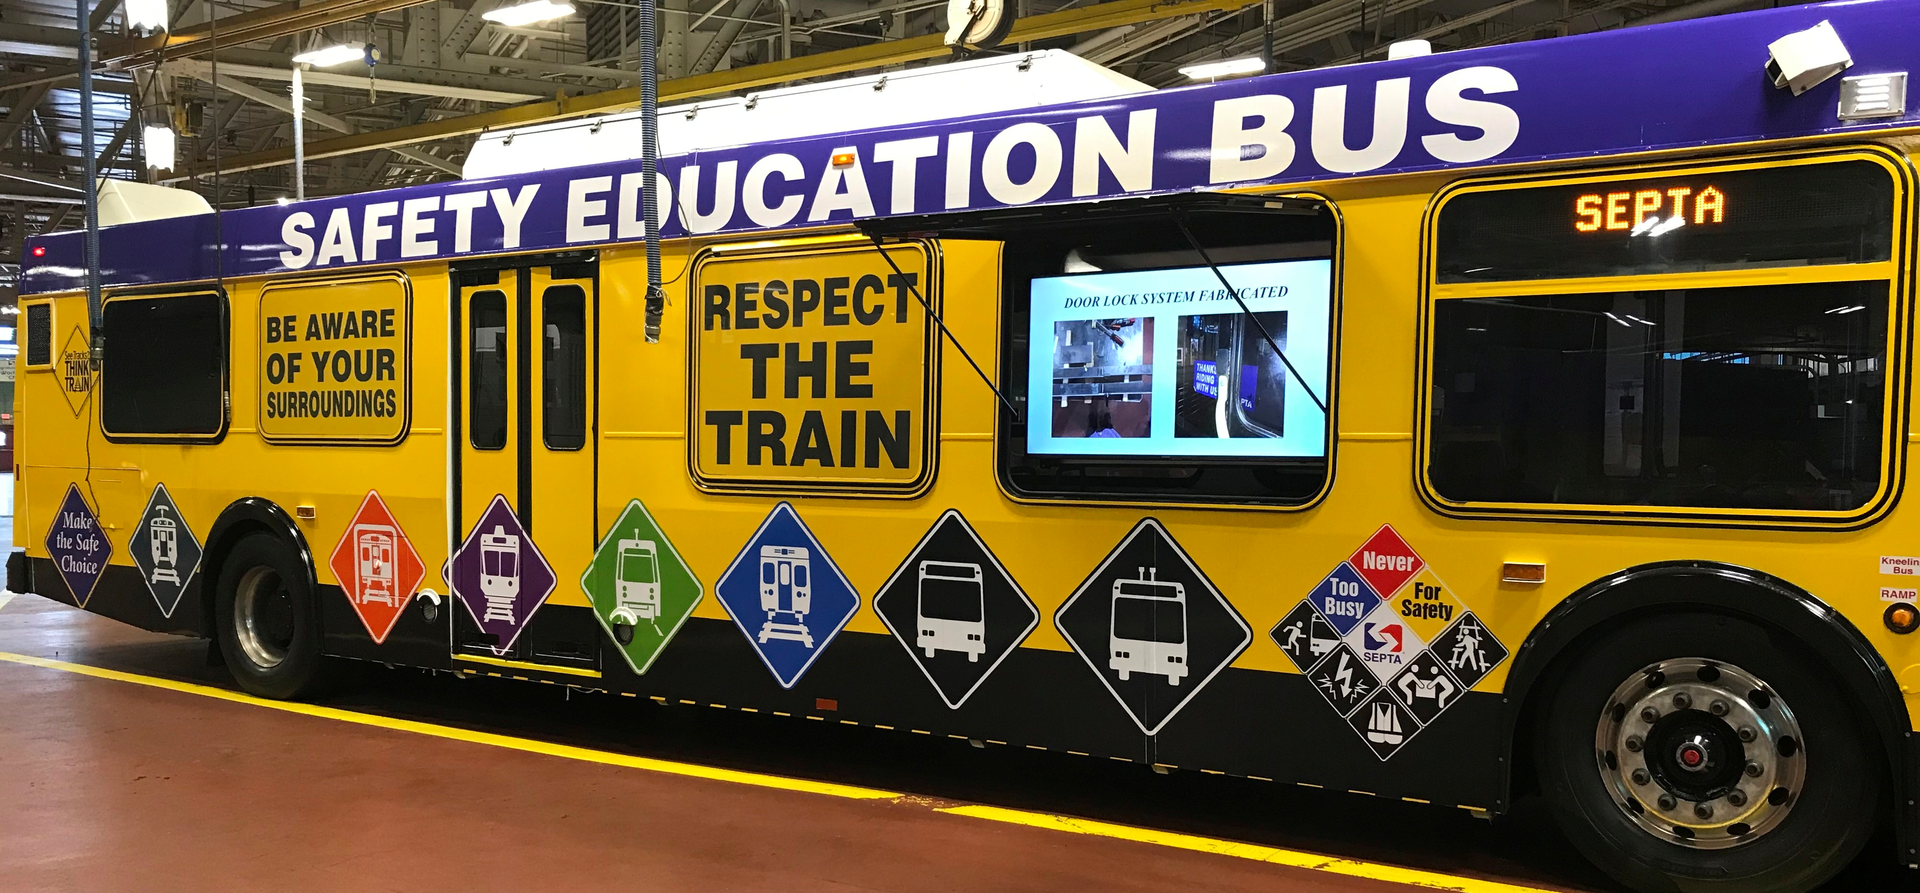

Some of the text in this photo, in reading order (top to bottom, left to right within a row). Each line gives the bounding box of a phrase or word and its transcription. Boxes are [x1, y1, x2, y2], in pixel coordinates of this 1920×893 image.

[279, 66, 1520, 270] SAFETY EDUCATION BUS
[1575, 186, 1724, 232] SEPTA
[704, 272, 918, 331] RESPECT
[1064, 286, 1289, 309] DOOR LOCK SYSTEM FABRICATED
[266, 308, 396, 343] BE AWARE
[64, 351, 73, 360] See
[65, 360, 89, 377] THINK
[266, 348, 396, 385] OF YOUR
[740, 340, 873, 399] THE
[1196, 372, 1215, 385] RIDING
[1196, 382, 1209, 393] WITH
[266, 388, 397, 419] SURROUNDINGS
[1241, 398, 1253, 409] PTA
[705, 410, 911, 469] TRAIN
[63, 512, 93, 530] Make
[57, 531, 100, 556] the Safe
[61, 555, 98, 575] Choice
[1363, 551, 1415, 572] Never
[1881, 557, 1920, 567] Kneelin
[1893, 566, 1914, 575] Bus
[1329, 577, 1359, 597] Too
[1414, 582, 1442, 601] For
[1881, 589, 1916, 600] RAMP
[1325, 597, 1365, 620] Busy
[1401, 599, 1453, 622] Safety
[1363, 651, 1402, 665] SEPTA
